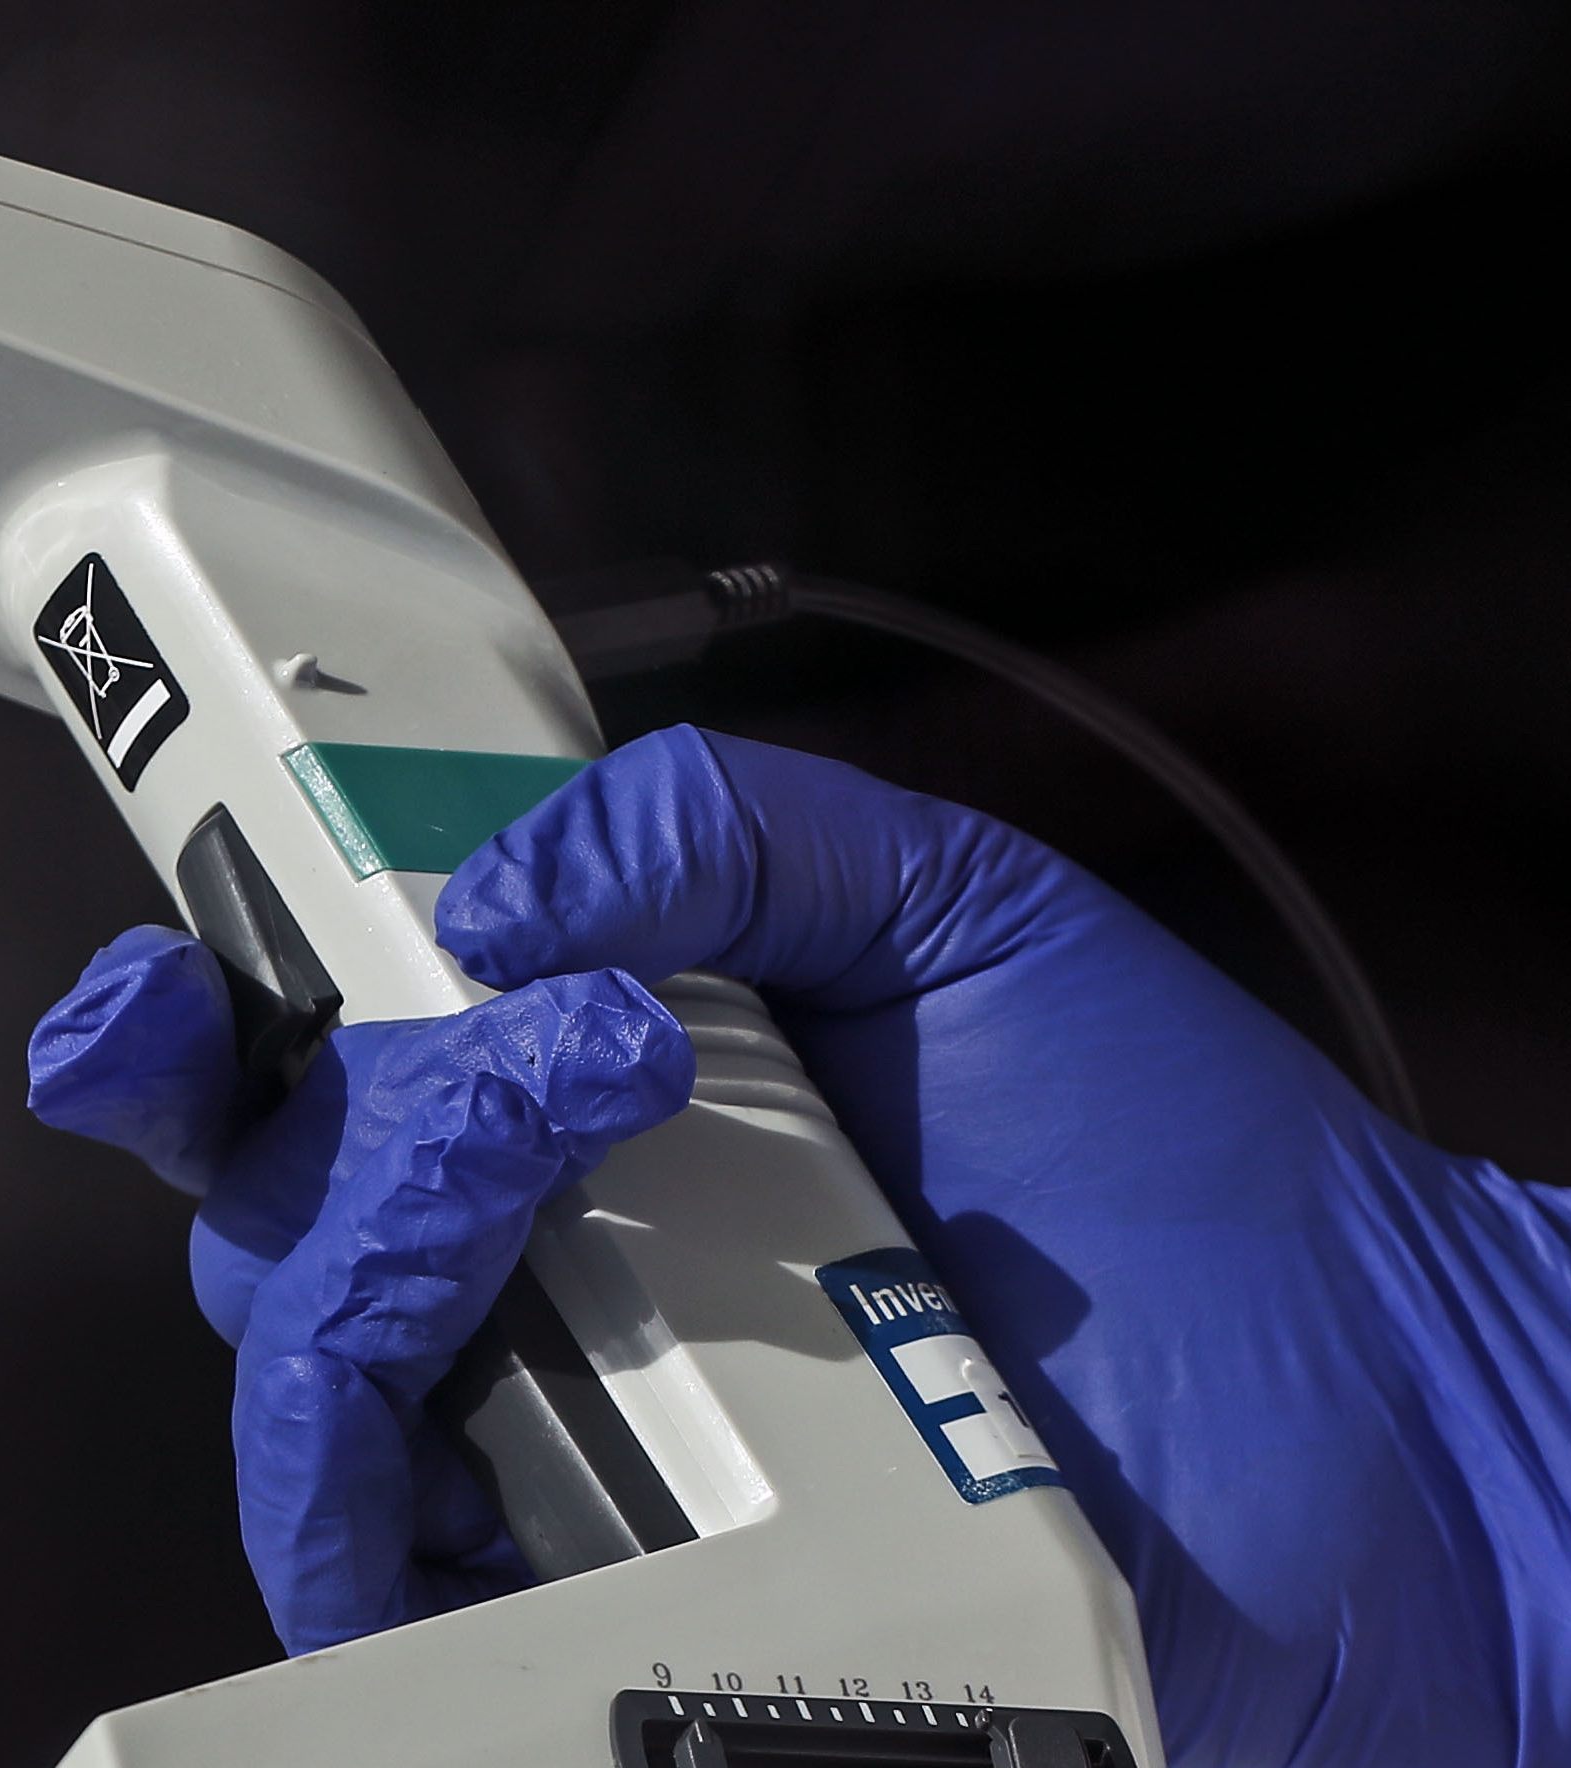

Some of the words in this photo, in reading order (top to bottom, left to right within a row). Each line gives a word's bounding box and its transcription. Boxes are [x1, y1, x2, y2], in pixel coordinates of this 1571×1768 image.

[652, 1662, 672, 1689] 9
[711, 1672, 743, 1692] 10
[776, 1674, 807, 1695] 11
[839, 1678, 870, 1698] 12
[901, 1681, 934, 1701] 13
[964, 1684, 995, 1705] 14
